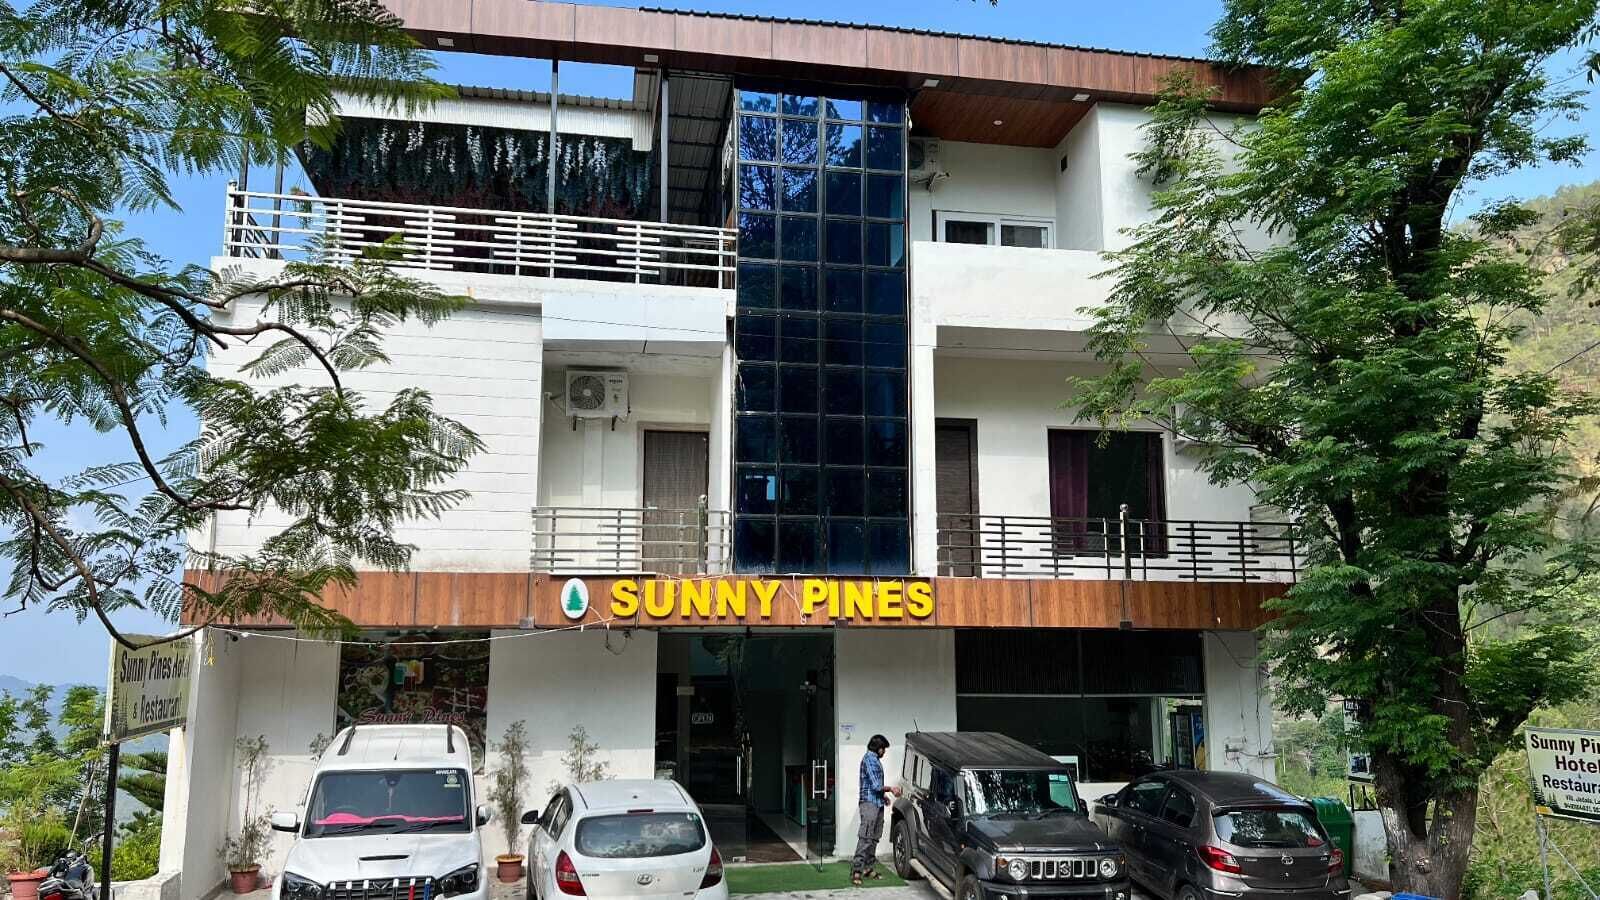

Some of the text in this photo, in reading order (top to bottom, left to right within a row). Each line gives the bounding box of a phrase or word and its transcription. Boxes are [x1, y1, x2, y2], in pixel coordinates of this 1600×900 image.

[610, 579, 935, 619] SUNNY PINES
[120, 651, 147, 688] Sunny
[149, 650, 172, 680] Pines
[140, 692, 182, 722] Restaurant
[1530, 734, 1575, 755] Sunny
[1542, 774, 1600, 794] Restaur
